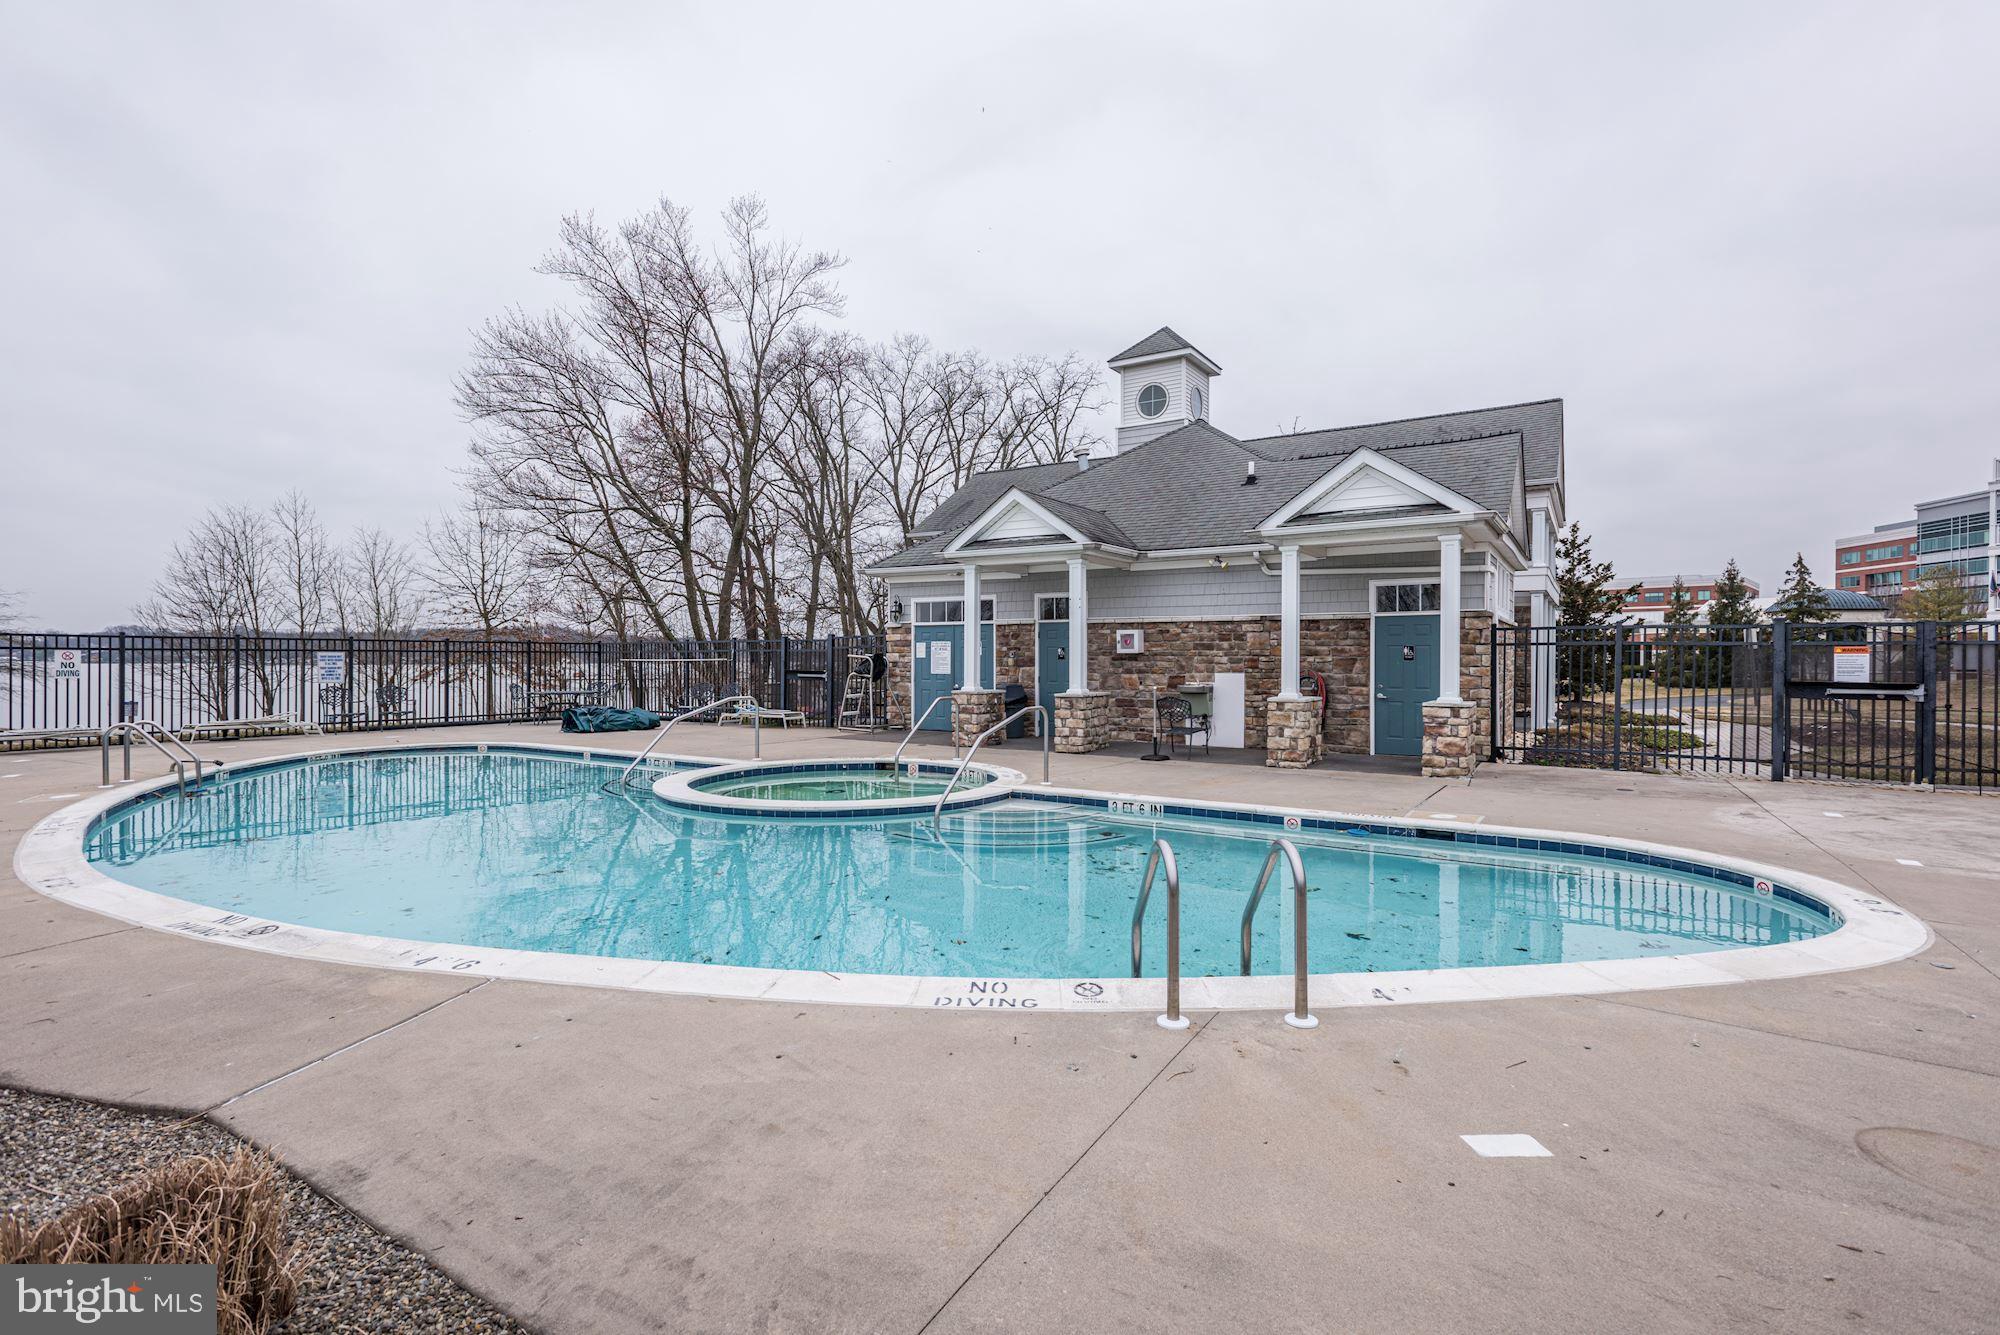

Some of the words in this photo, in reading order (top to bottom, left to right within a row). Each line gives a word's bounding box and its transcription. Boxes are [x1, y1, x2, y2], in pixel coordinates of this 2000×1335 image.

[61, 661, 75, 669] NO
[968, 981, 1008, 994] NO
[933, 996, 1039, 1008] DIVING
